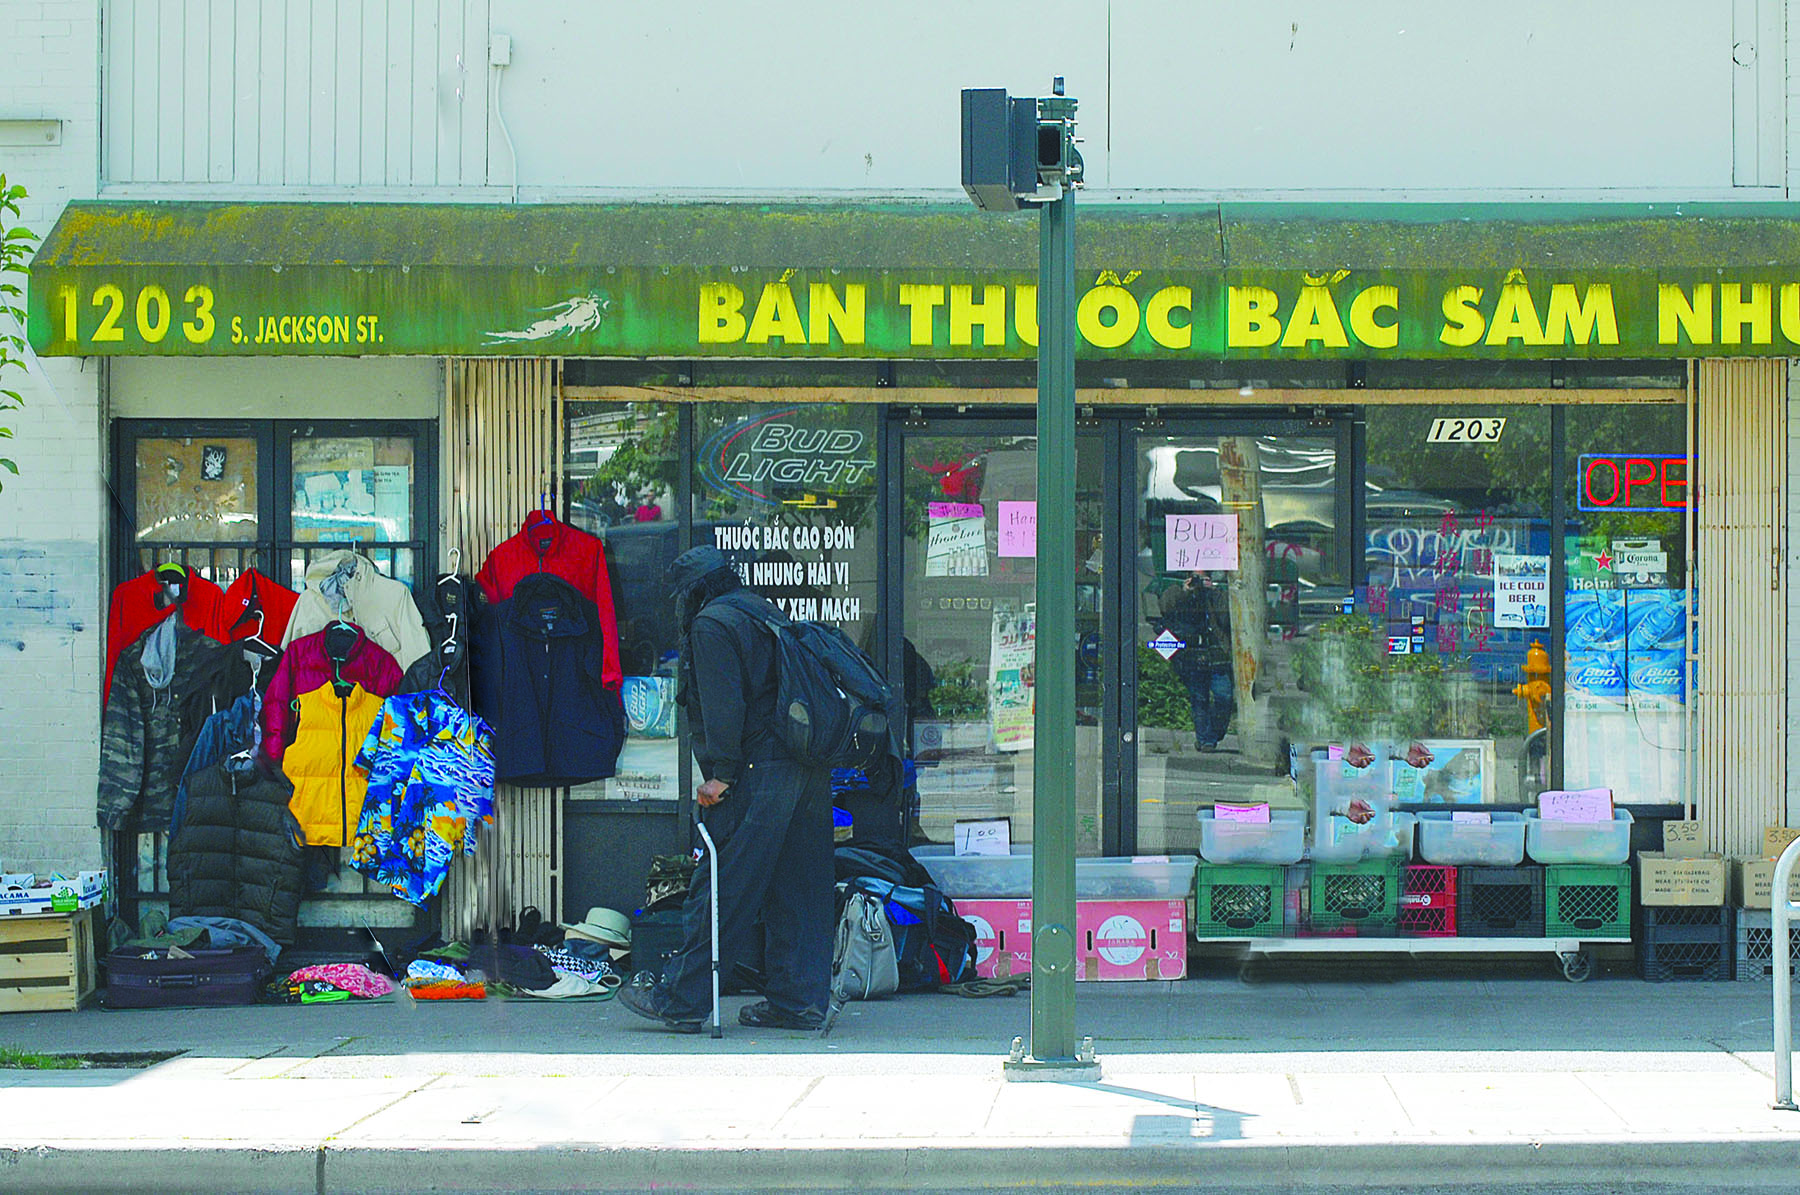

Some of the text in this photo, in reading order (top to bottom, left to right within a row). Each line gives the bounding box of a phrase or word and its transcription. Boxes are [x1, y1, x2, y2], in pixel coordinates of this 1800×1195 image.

[60, 283, 384, 344] 1203 S. JACKSON ST.
[698, 267, 866, 344] BÁN
[1227, 268, 1399, 349] BẮC
[1439, 267, 1620, 346] SÂM
[751, 423, 864, 453] BUD
[1434, 420, 1502, 440] 1203
[724, 453, 877, 484] LIGHT
[1585, 458, 1689, 507] OPE
[714, 517, 760, 550] THUỐC
[763, 514, 789, 550] BẮC
[792, 526, 820, 550] CAO
[1174, 518, 1229, 543] BUD
[753, 562, 804, 586] NHUNG
[807, 553, 831, 586] HẢI
[834, 562, 849, 591] VỊ
[1626, 553, 1658, 566] Corona
[1499, 582, 1545, 591] ICE COLD
[1508, 594, 1536, 603] BEER
[788, 598, 818, 621] XEM
[821, 598, 860, 628] MẠCH
[1577, 676, 1620, 686] LIGHT
[1584, 667, 1616, 677] BUD
[1639, 676, 1682, 686] LIGHT
[1645, 667, 1679, 677] BUD
[630, 684, 640, 716] BUD
[637, 680, 648, 723] LIGHT
[1666, 822, 1699, 842] 3.50
